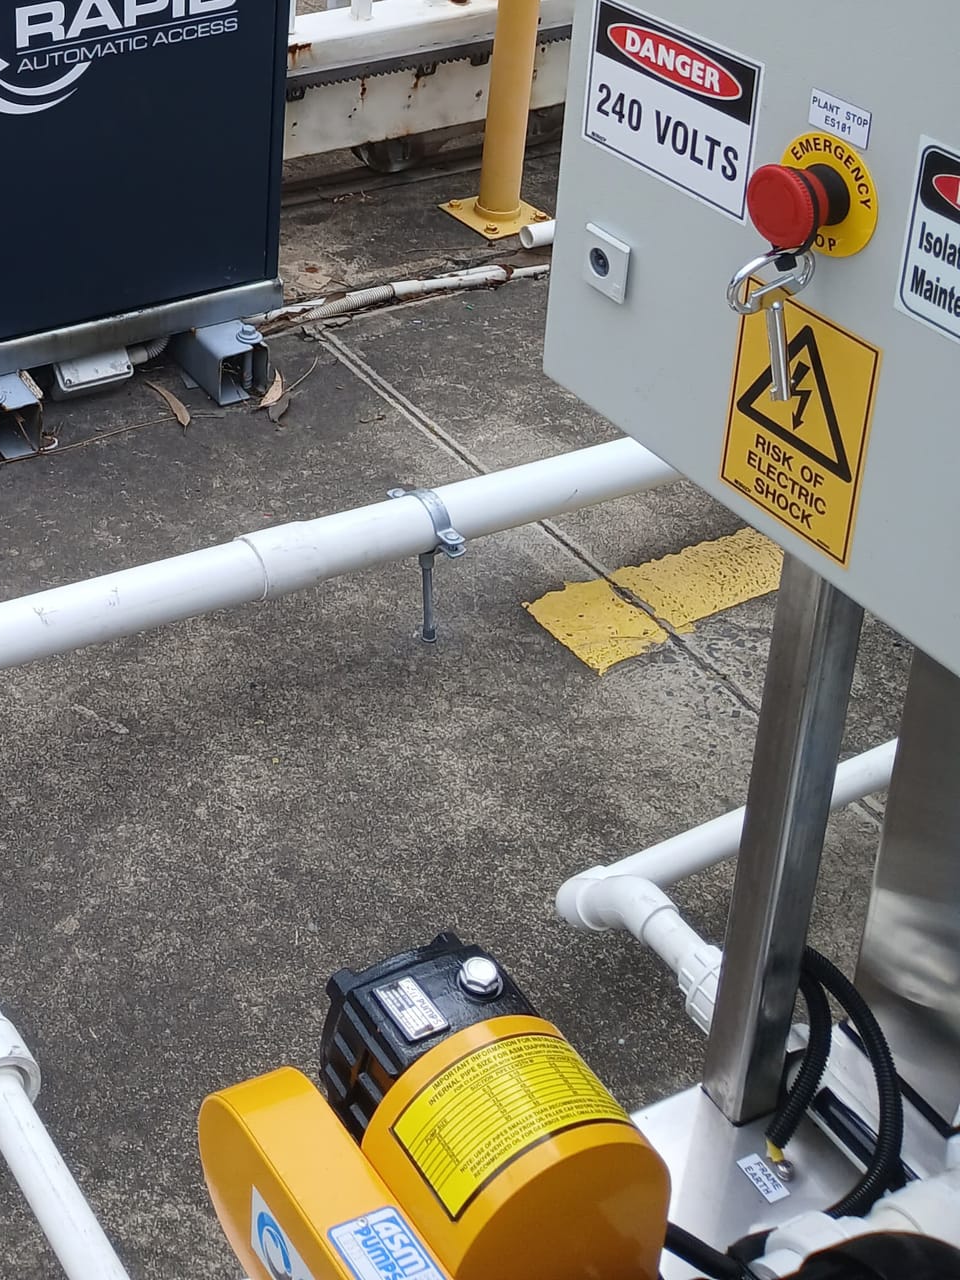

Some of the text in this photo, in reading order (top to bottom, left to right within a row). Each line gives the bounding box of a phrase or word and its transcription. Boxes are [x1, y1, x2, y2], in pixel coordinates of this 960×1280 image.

[16, 17, 239, 74] AUTOMATIC ACCESS
[624, 29, 721, 93] DANGER
[596, 83, 739, 181] 240 VOLTS
[812, 96, 869, 127] PLANT STOP
[791, 137, 872, 210] EMERGENCY
[747, 449, 827, 515] ELECTRIC
[755, 433, 825, 488] RISK OF
[754, 477, 813, 530] SHOCK
[428, 1077, 460, 1106] INTERNAL
[460, 1065, 477, 1079] PIPE
[477, 1058, 492, 1069] SIZE
[432, 1059, 471, 1090] IMPORTANT
[471, 1040, 517, 1063] INFORMATION
[744, 1165, 772, 1195] EARTH
[754, 1161, 783, 1191] FRAME
